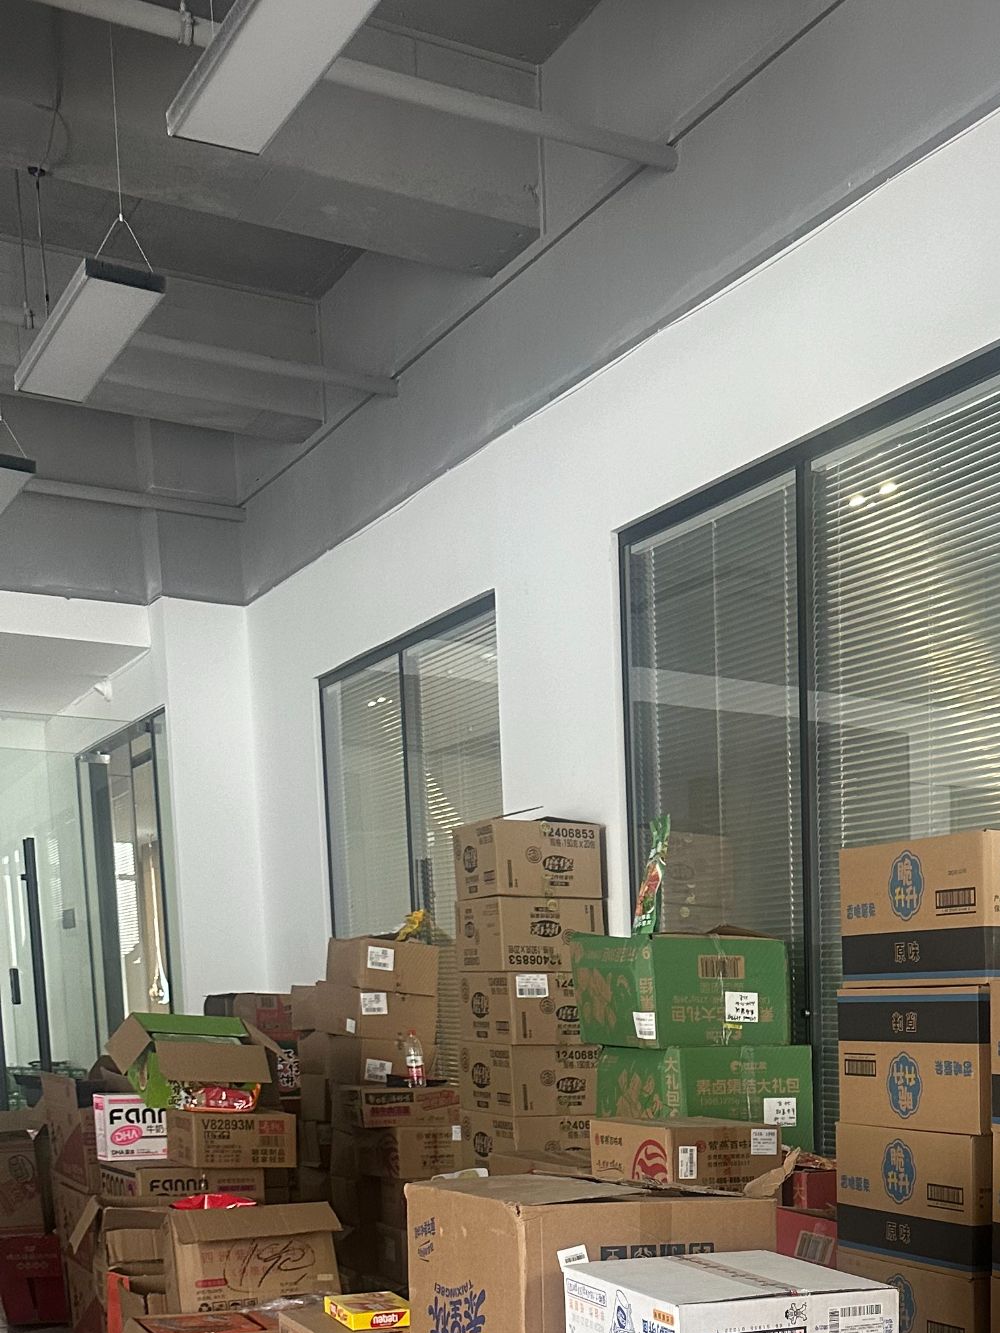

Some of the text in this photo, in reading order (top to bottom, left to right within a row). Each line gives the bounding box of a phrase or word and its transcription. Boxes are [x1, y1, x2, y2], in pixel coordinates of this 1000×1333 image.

[666, 1056, 680, 1108] 大礼包
[202, 1119, 255, 1130] V82893M
[115, 1129, 139, 1142] DHA
[434, 1280, 474, 1296] TAIXINGBEI
[373, 1313, 398, 1325] nabati
